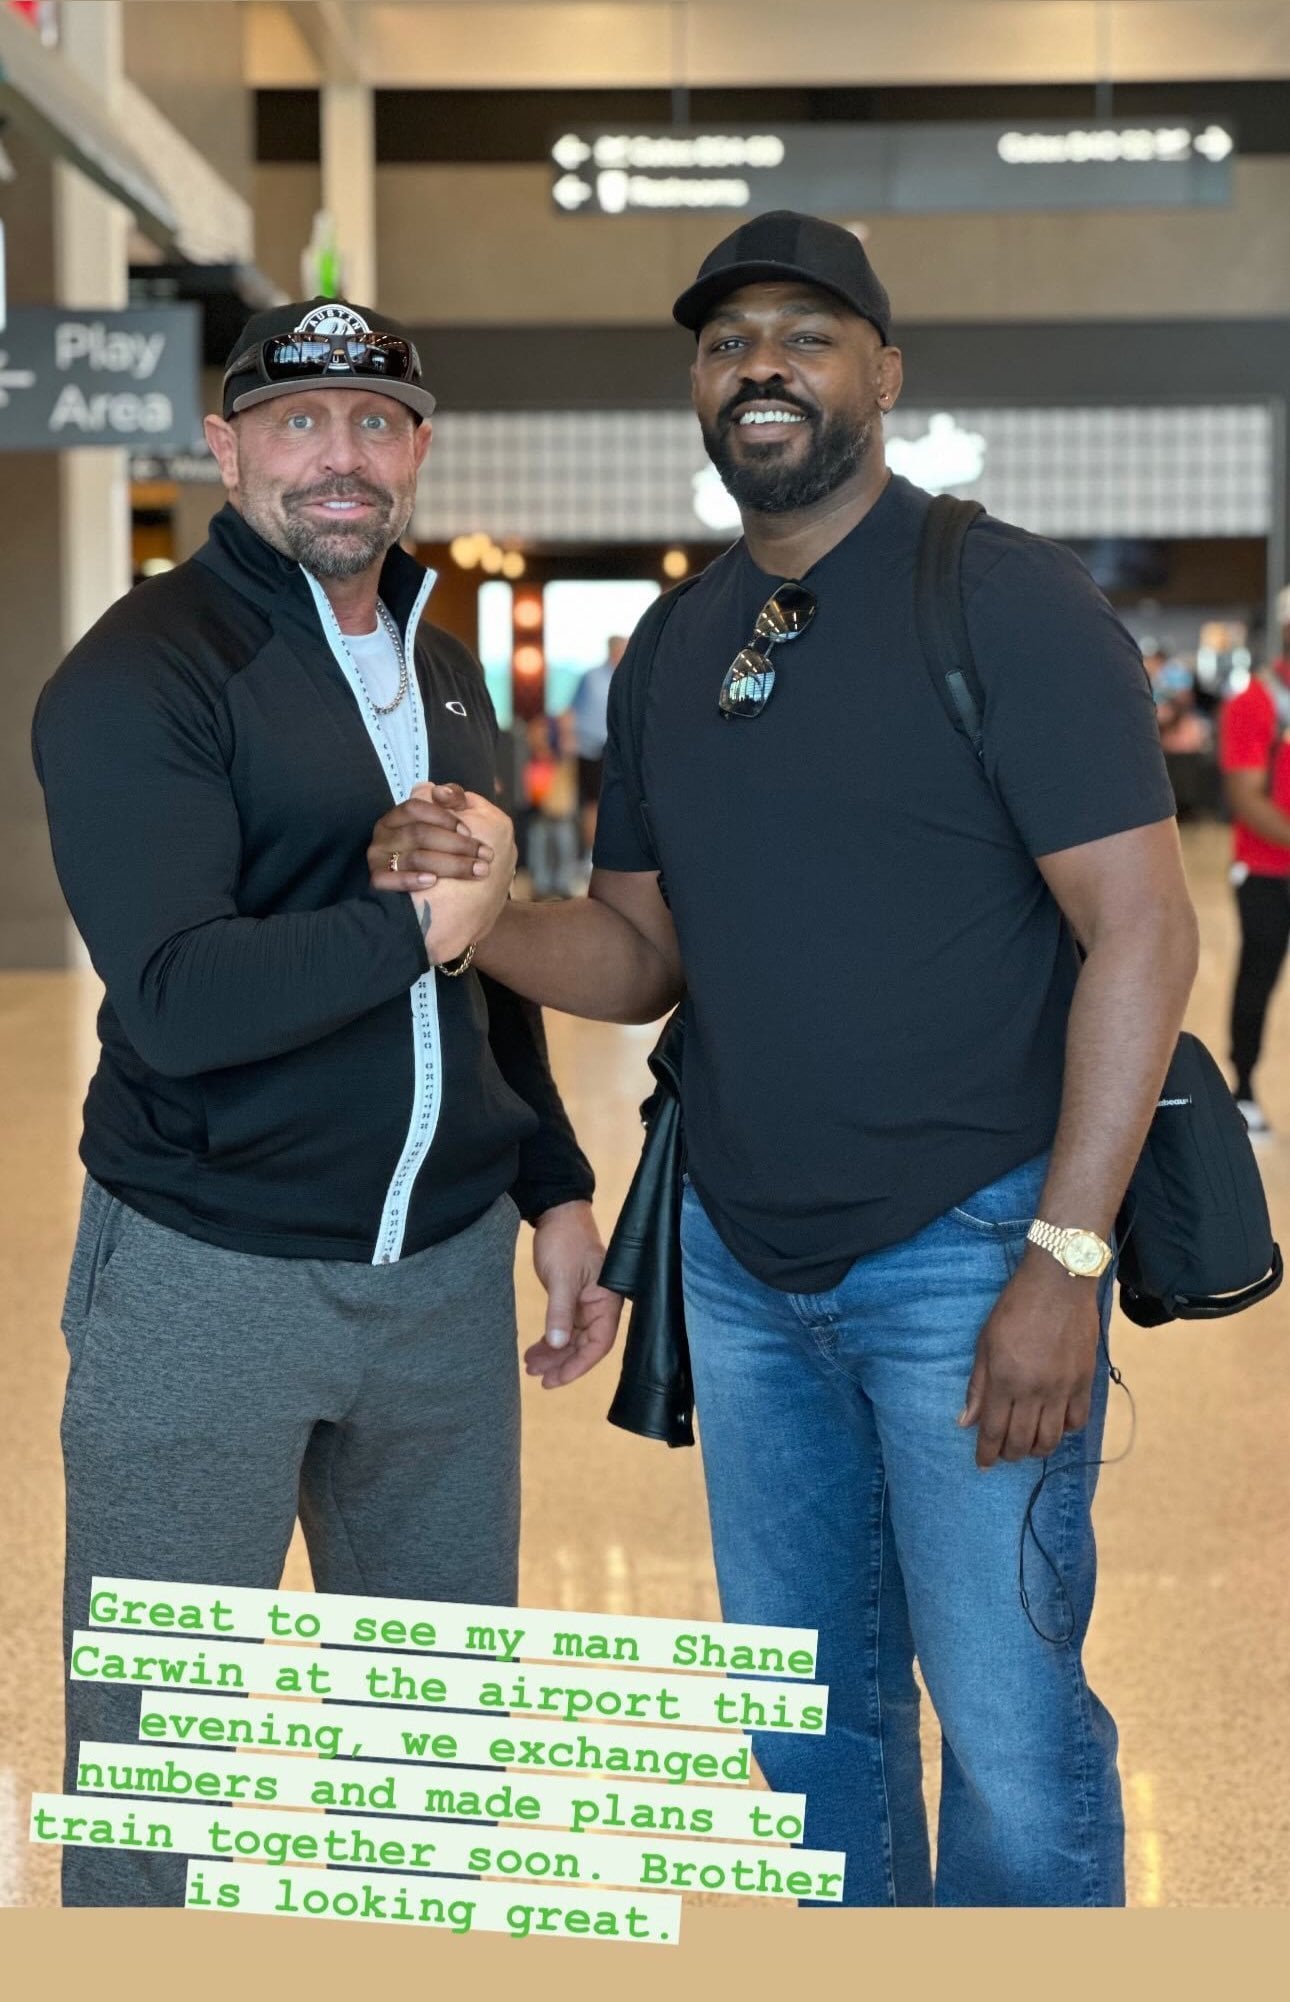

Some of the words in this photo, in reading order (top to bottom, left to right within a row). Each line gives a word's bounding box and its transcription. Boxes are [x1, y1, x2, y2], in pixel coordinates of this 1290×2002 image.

[310, 308, 361, 331] AUSTIN
[55, 322, 166, 379] Play
[48, 384, 173, 432] Area
